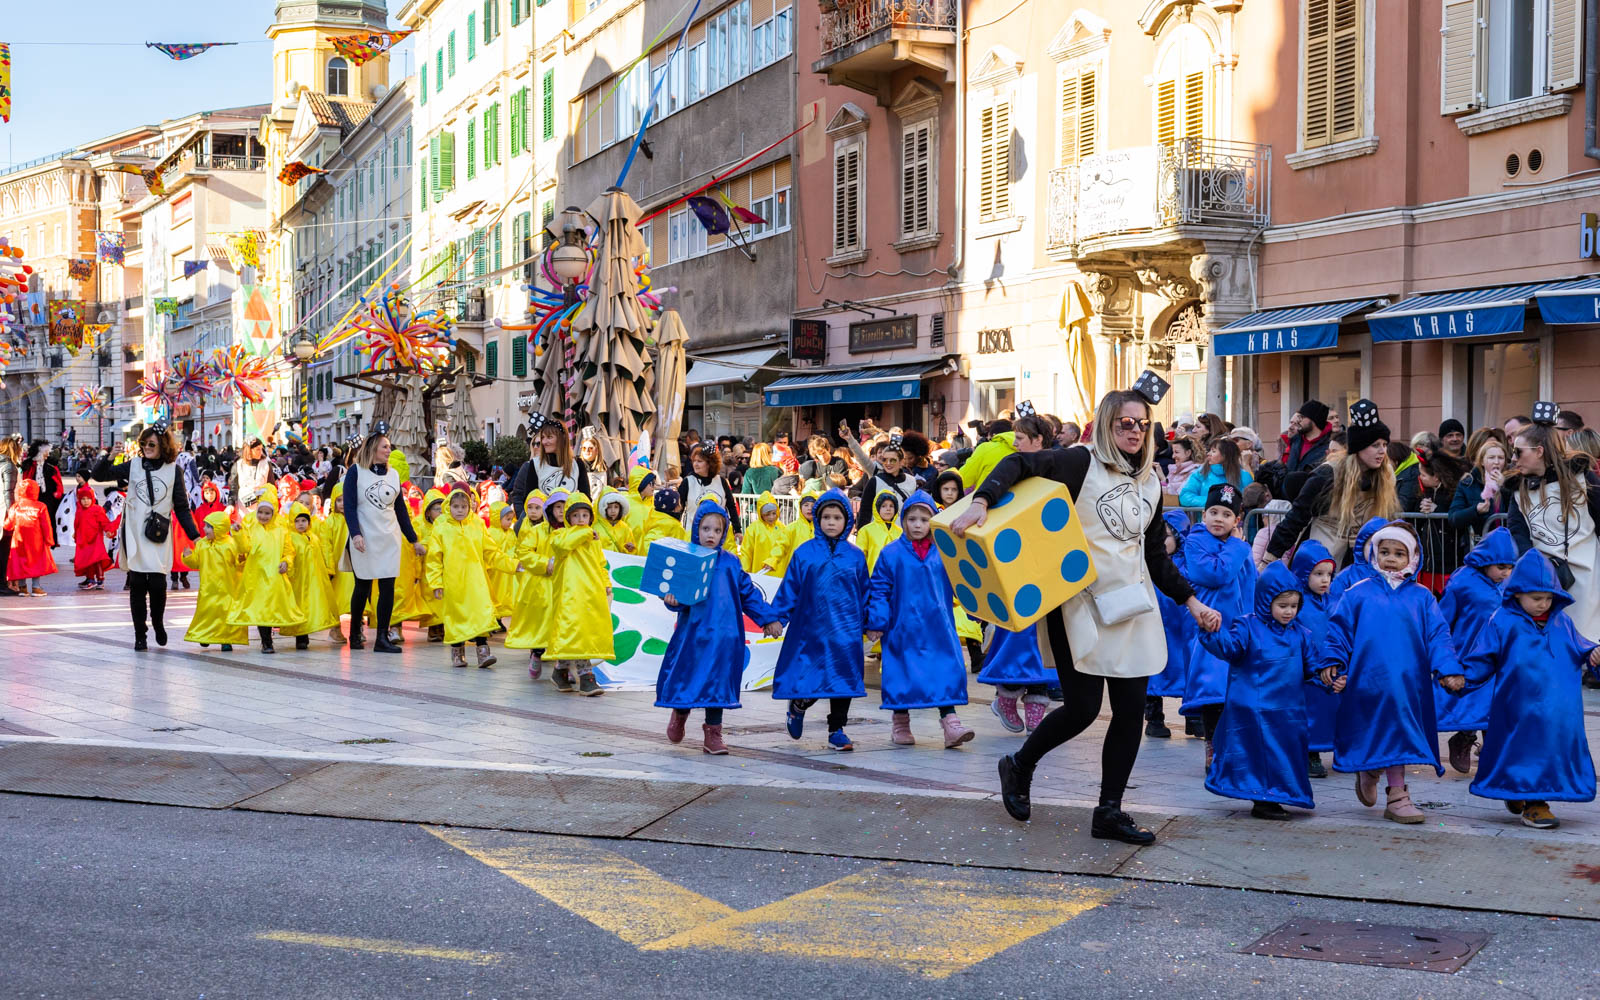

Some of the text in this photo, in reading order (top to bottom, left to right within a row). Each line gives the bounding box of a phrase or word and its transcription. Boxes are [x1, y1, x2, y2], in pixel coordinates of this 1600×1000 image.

[1413, 310, 1474, 337] KRAŠ
[794, 336, 824, 351] PUNCH
[976, 326, 1015, 354] LISCA
[1248, 327, 1298, 352] KRAŠ
